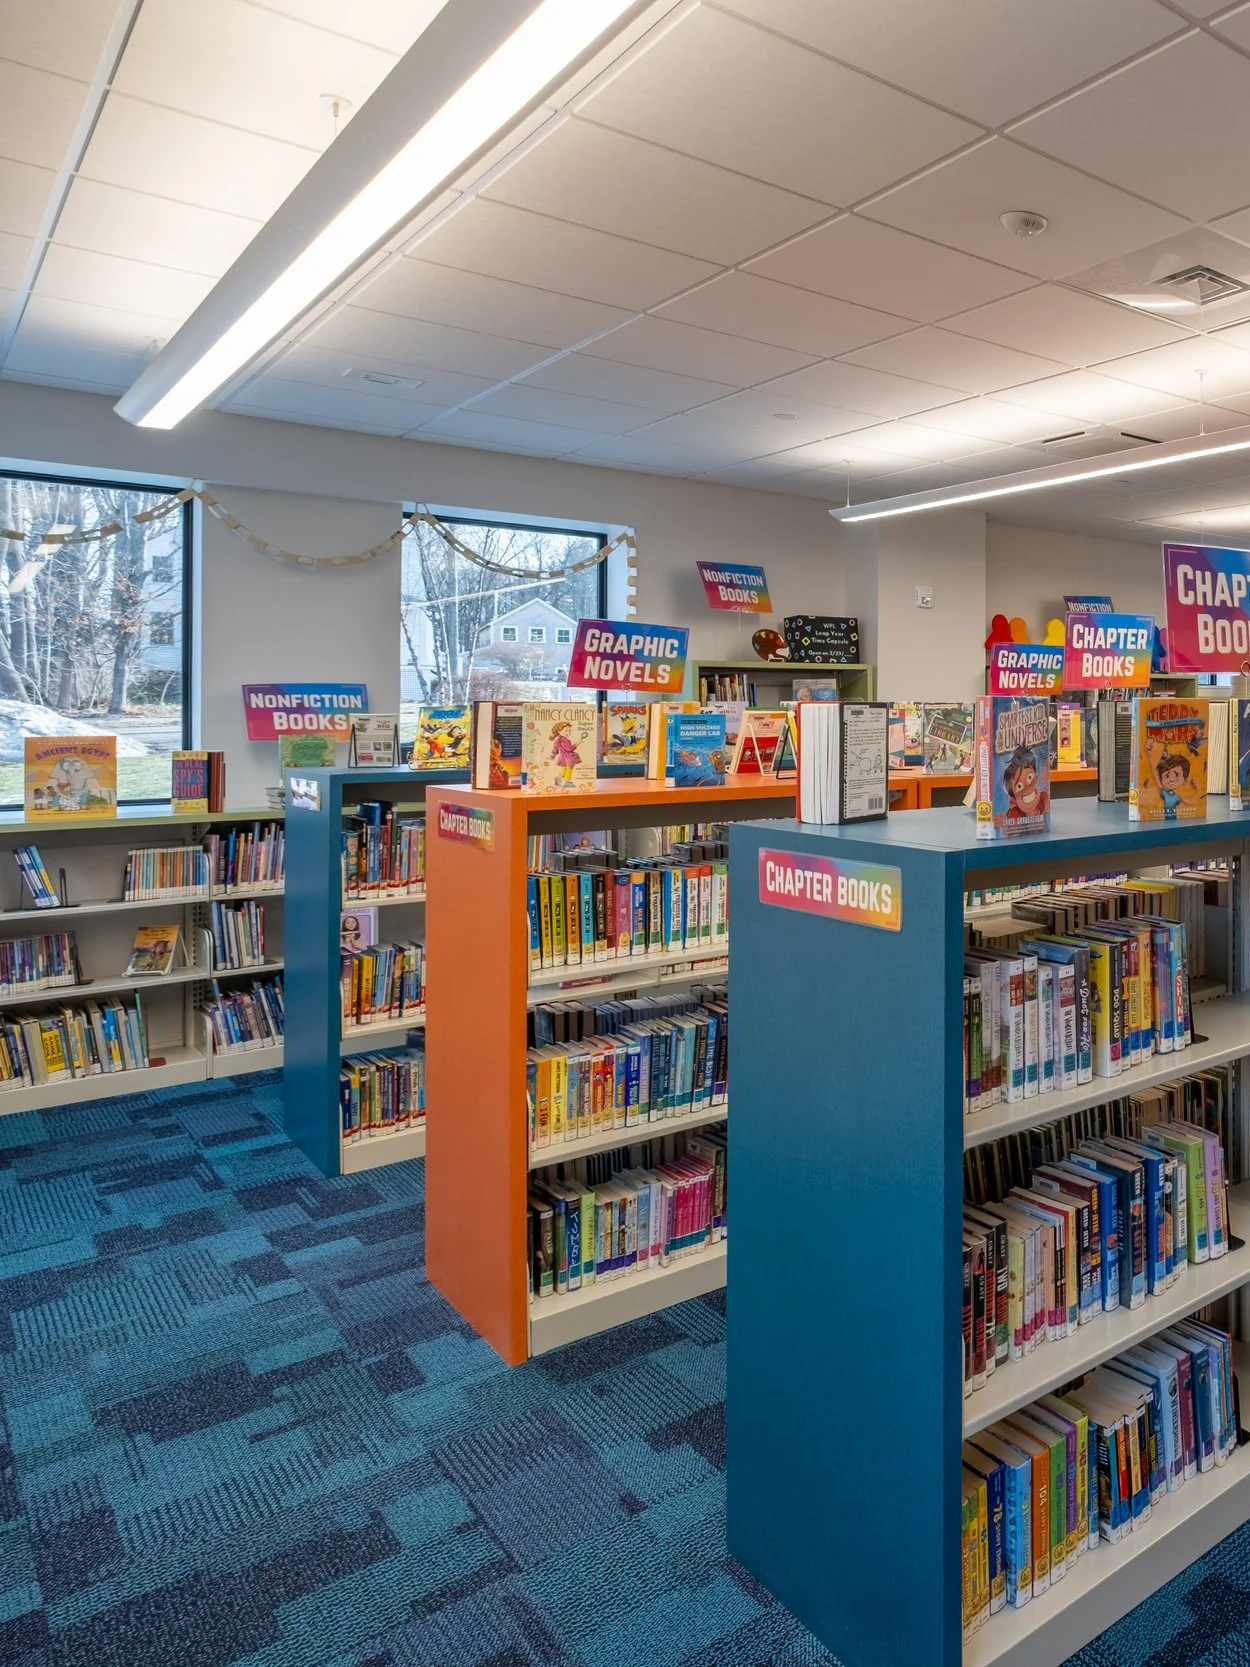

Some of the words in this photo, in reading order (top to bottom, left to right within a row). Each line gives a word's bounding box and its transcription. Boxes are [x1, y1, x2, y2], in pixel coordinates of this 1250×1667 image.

[702, 569, 764, 587] NONFICTION
[718, 585, 759, 604] BOOKS
[1067, 601, 1112, 613] NONFICTION
[584, 628, 679, 659] GRAPHIC
[826, 637, 849, 645] Capsule
[1072, 624, 1148, 650] CHAPTER
[997, 650, 1063, 670] GRAPHIC
[1081, 653, 1135, 677] BOOKS
[583, 656, 671, 684] NOVELS
[998, 671, 1056, 690] NOVELS
[250, 693, 362, 709] NONFICTION
[273, 711, 347, 730] BOOKS
[609, 705, 647, 717] SPARKS
[1000, 706, 1034, 731] SMARTEST
[1034, 704, 1046, 720] KID
[1149, 703, 1199, 721] TEDDY
[35, 746, 79, 761] ANCIENT
[80, 746, 111, 760] EGYPT
[174, 769, 204, 785] SPY'S
[174, 784, 204, 798] GUIDE
[439, 809, 468, 836] CHAPTER
[468, 818, 491, 841] BOOKS
[766, 860, 832, 903] CHAPTER
[837, 875, 893, 914] BOOKS
[706, 1046, 715, 1059] THE
[706, 1061, 715, 1077] BEST
[997, 1265, 1008, 1291] TWO
